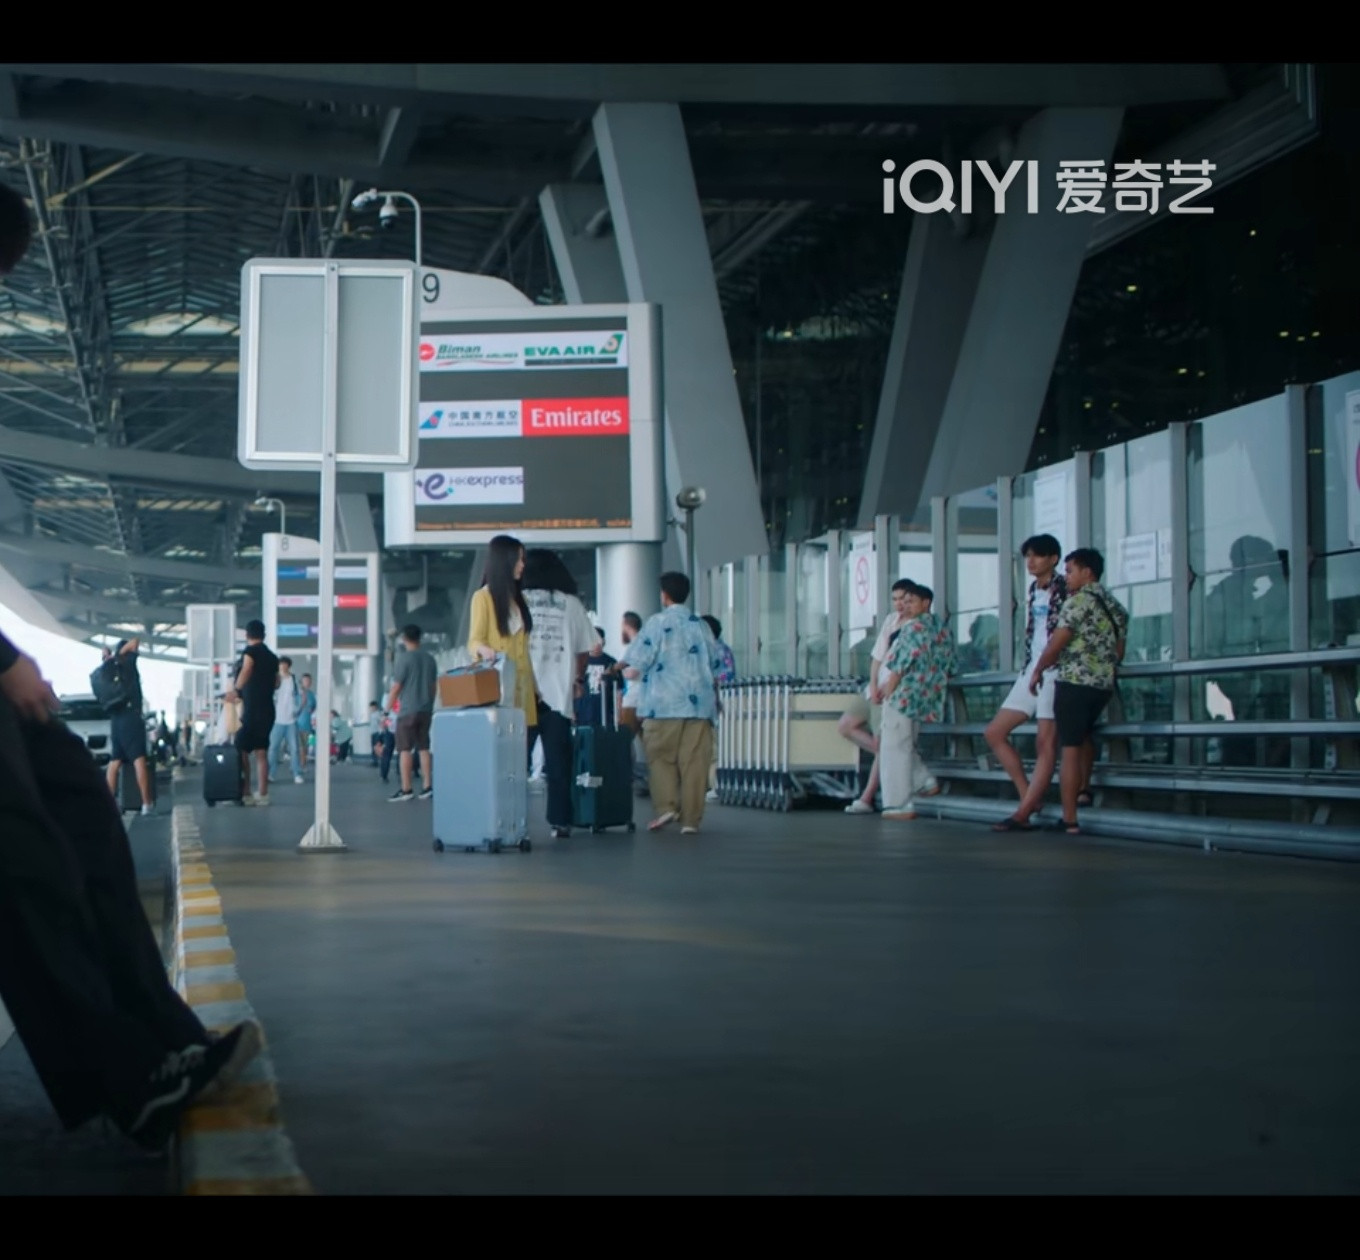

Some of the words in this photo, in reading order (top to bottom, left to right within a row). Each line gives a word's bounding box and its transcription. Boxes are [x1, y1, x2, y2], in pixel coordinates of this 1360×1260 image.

[422, 273, 440, 303] 9
[438, 343, 482, 354] Biman
[531, 406, 623, 428] Emirates
